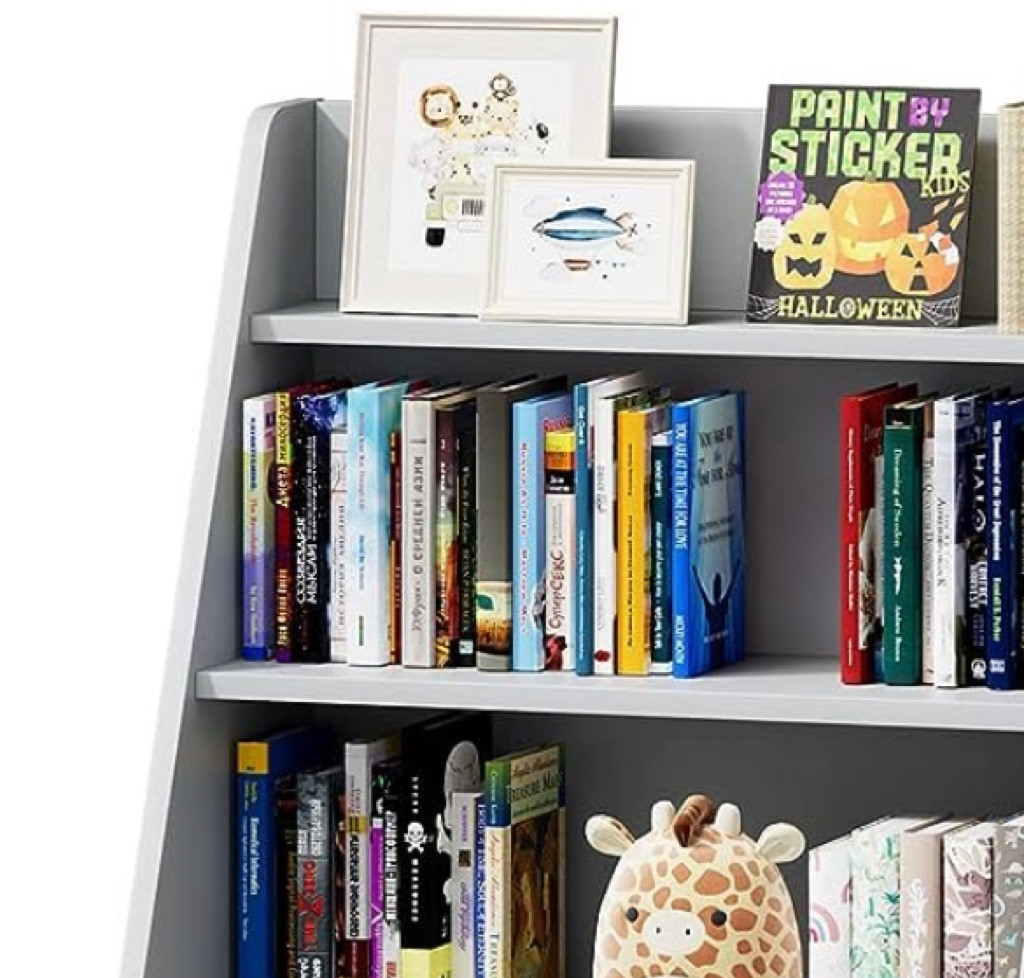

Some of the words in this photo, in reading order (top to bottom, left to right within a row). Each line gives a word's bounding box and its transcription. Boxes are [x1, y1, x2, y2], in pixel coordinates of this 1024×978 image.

[790, 88, 907, 130] PAINT
[908, 96, 951, 128] BY
[768, 128, 962, 179] STICKER
[920, 170, 971, 198] KIDS
[777, 296, 923, 320] HALLOWEEN
[974, 454, 987, 532] HALO
